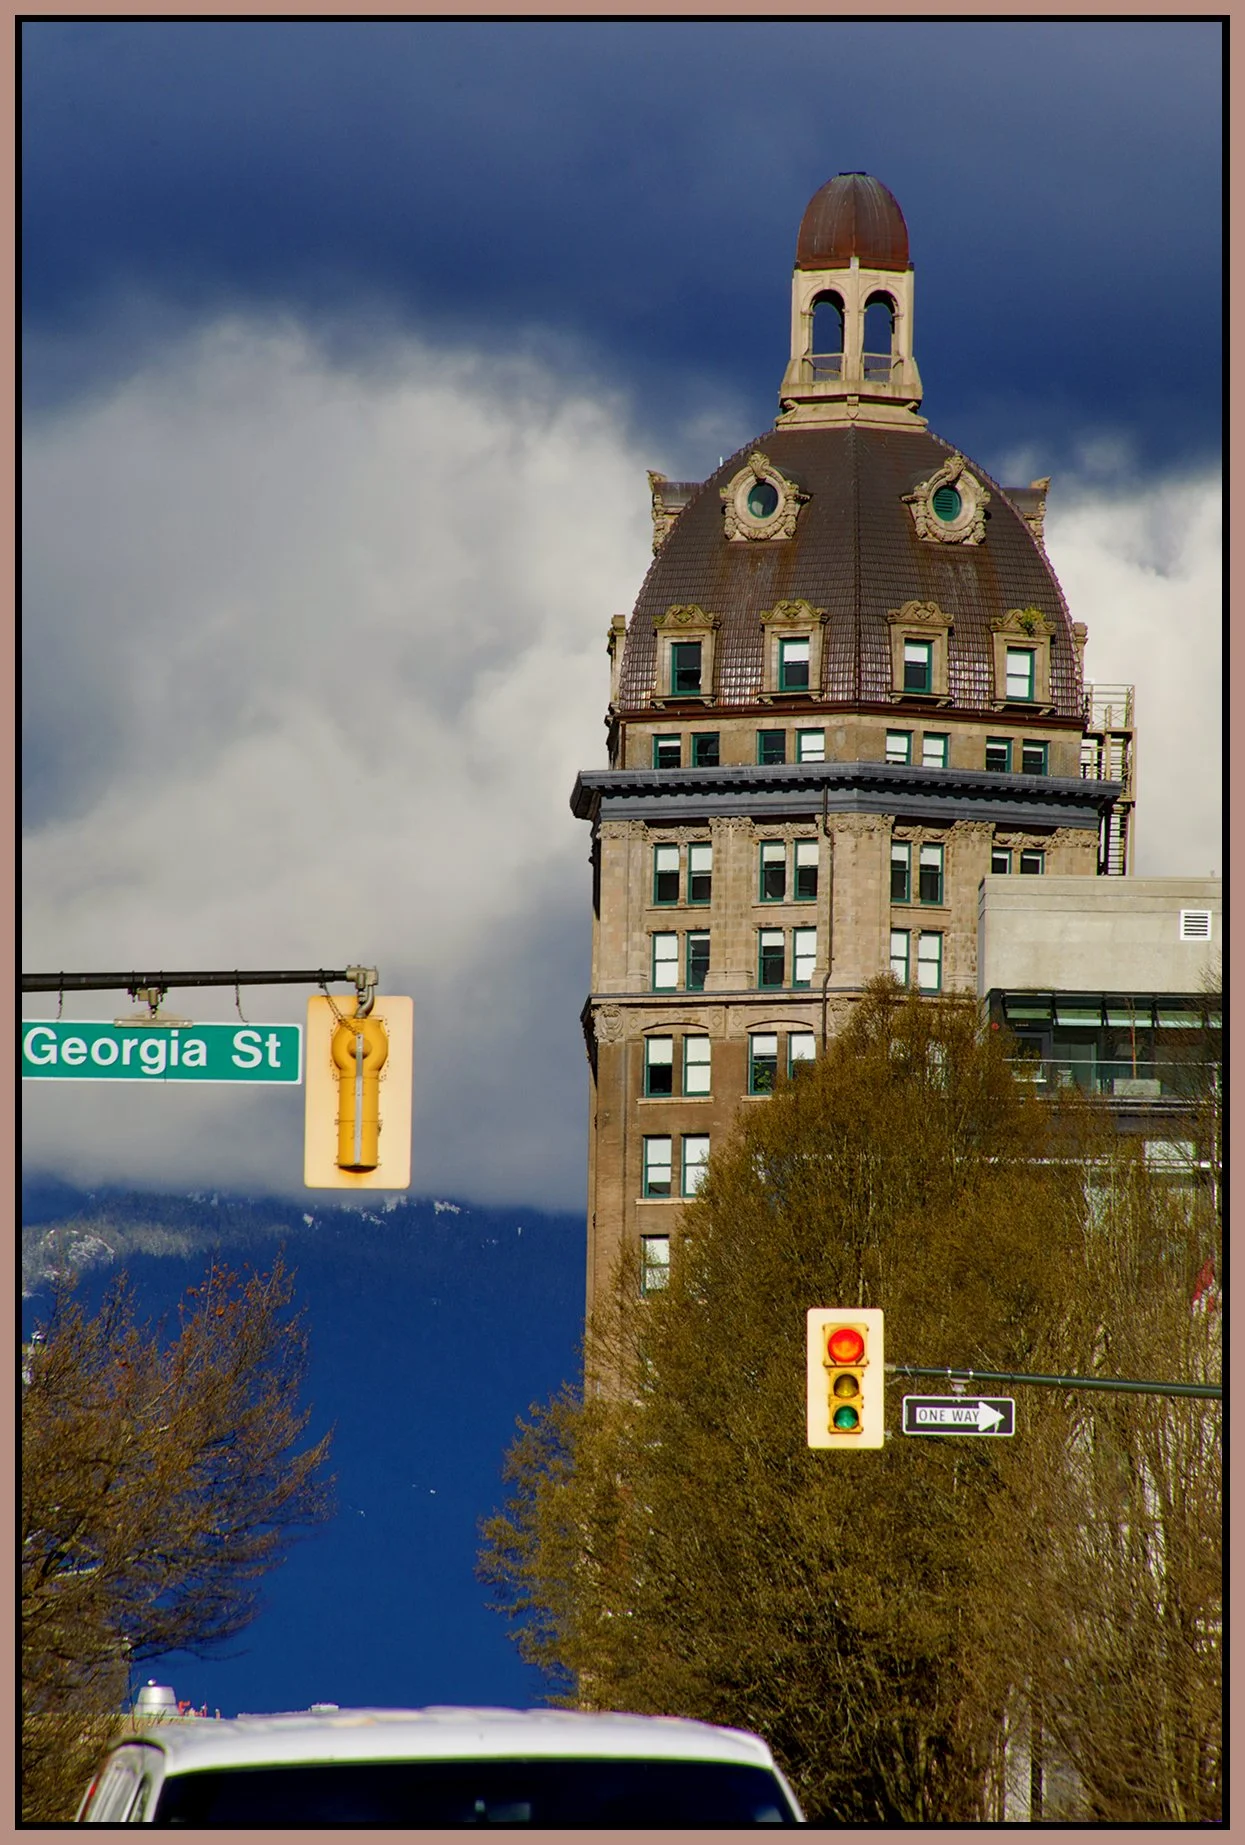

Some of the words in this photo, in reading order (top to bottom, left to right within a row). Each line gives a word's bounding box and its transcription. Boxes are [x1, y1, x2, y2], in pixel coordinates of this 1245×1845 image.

[23, 1026, 207, 1075] Georgia
[231, 1030, 281, 1068] St
[918, 1408, 946, 1422] ONE
[952, 1409, 980, 1423] WAY
